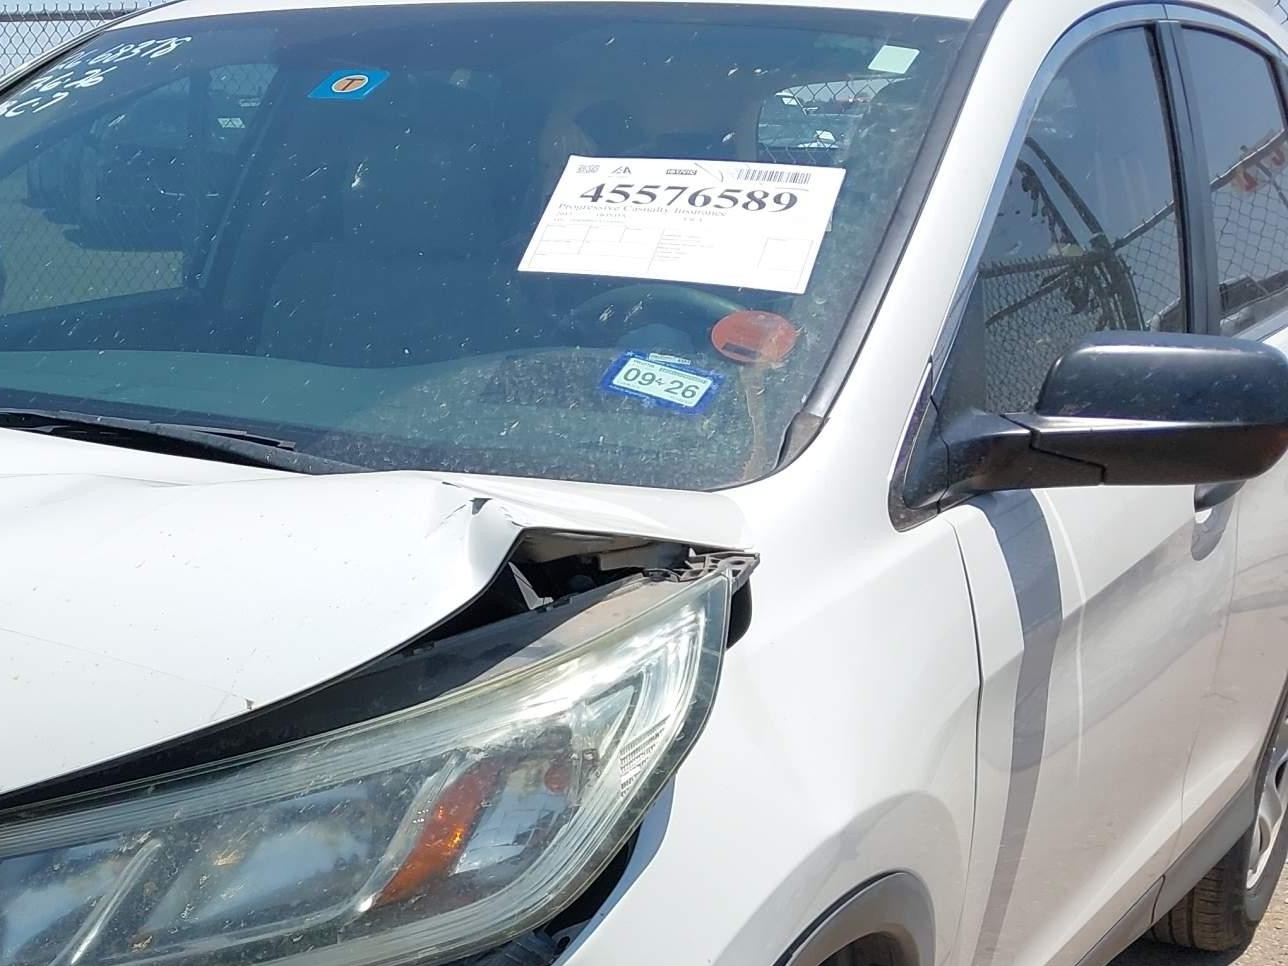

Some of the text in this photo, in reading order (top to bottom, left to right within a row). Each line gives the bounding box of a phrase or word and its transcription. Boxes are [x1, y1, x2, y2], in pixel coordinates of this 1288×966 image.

[341, 78, 365, 91] T
[579, 183, 799, 213] 45576589
[557, 203, 729, 217] Progressive Casualty Insurance
[622, 367, 656, 386] 09
[663, 379, 700, 399] 26
